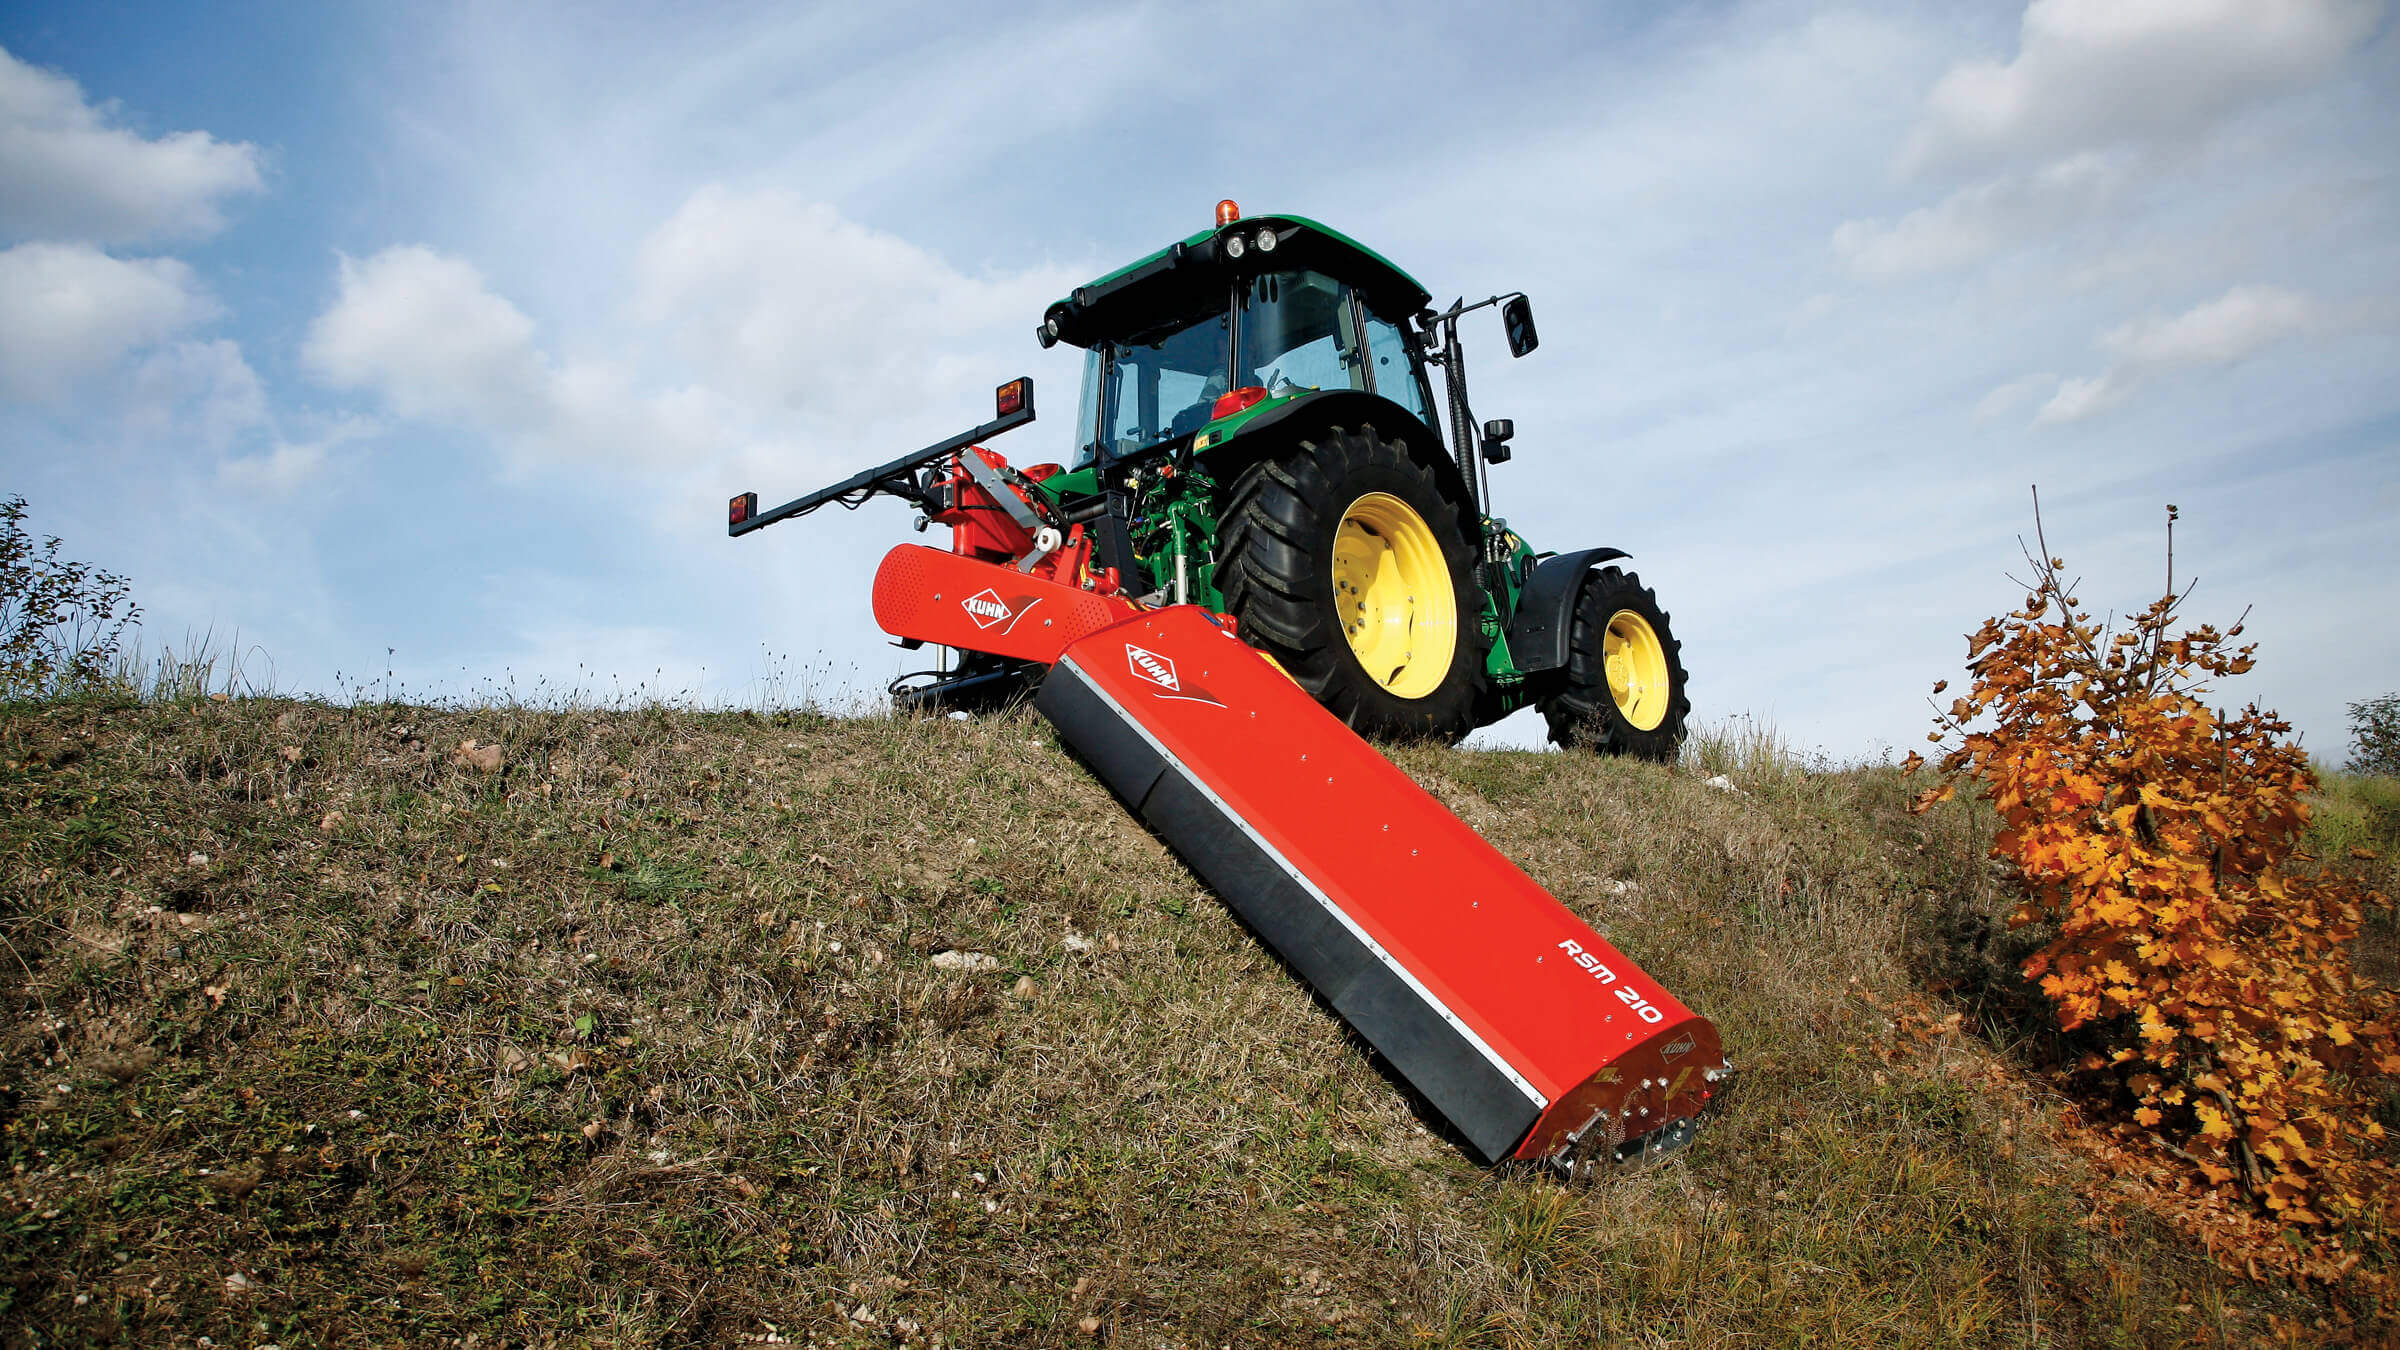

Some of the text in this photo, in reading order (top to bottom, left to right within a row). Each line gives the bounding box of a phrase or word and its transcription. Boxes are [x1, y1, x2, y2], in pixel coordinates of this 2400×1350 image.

[968, 598, 1005, 619] KUHN
[1130, 649, 1176, 686] KUHN
[1558, 939, 1664, 1024] RSM 210
